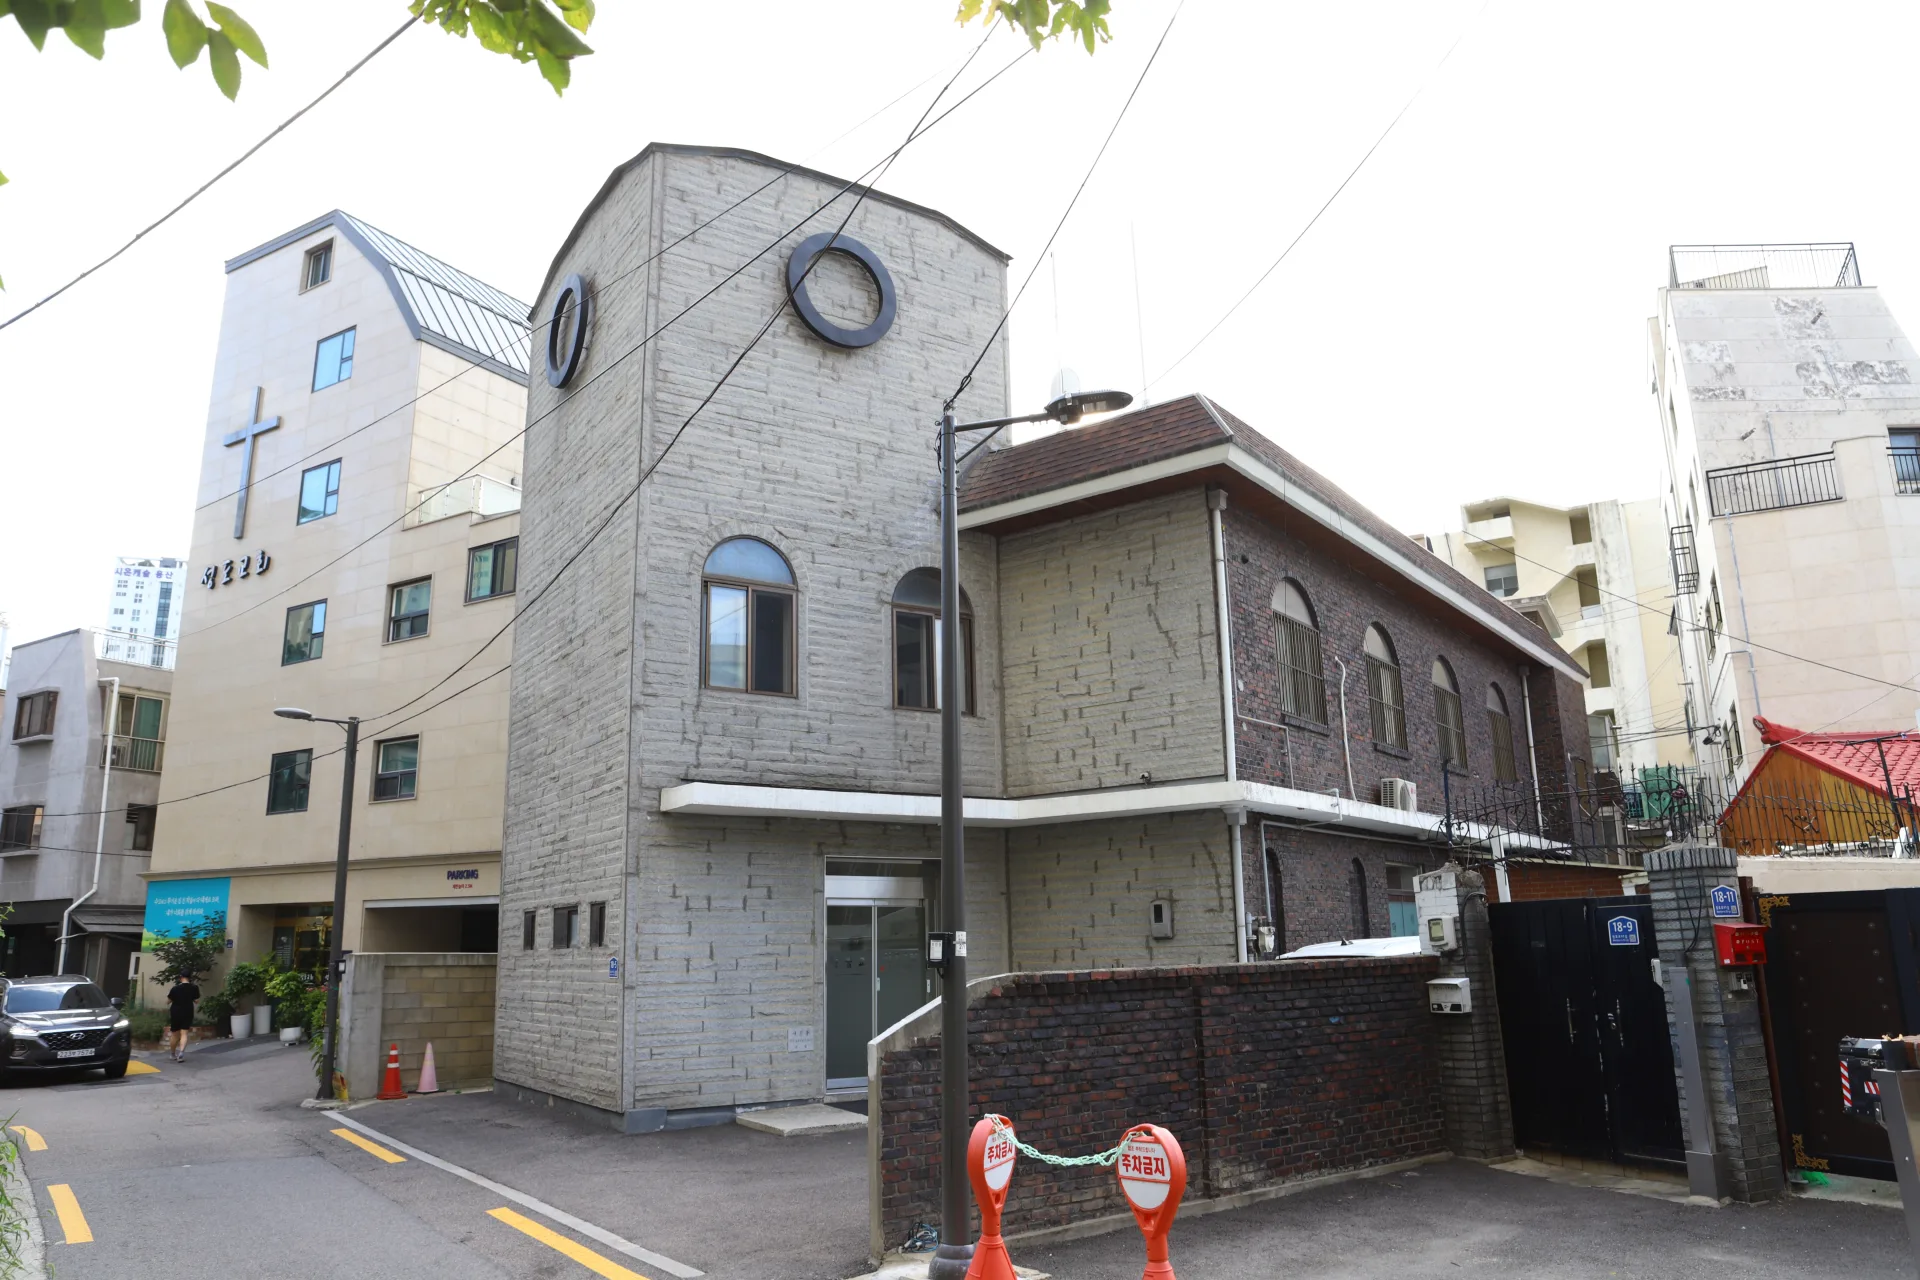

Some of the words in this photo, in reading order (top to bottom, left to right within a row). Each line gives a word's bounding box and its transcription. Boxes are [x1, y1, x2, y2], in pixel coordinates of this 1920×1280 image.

[155, 570, 174, 580] 용산
[201, 550, 271, 589] 성도교회
[447, 869, 479, 880] PARKING
[1714, 891, 1735, 903] 18-11
[1612, 921, 1633, 932] 18-9
[1122, 1153, 1165, 1177] 주차금지
